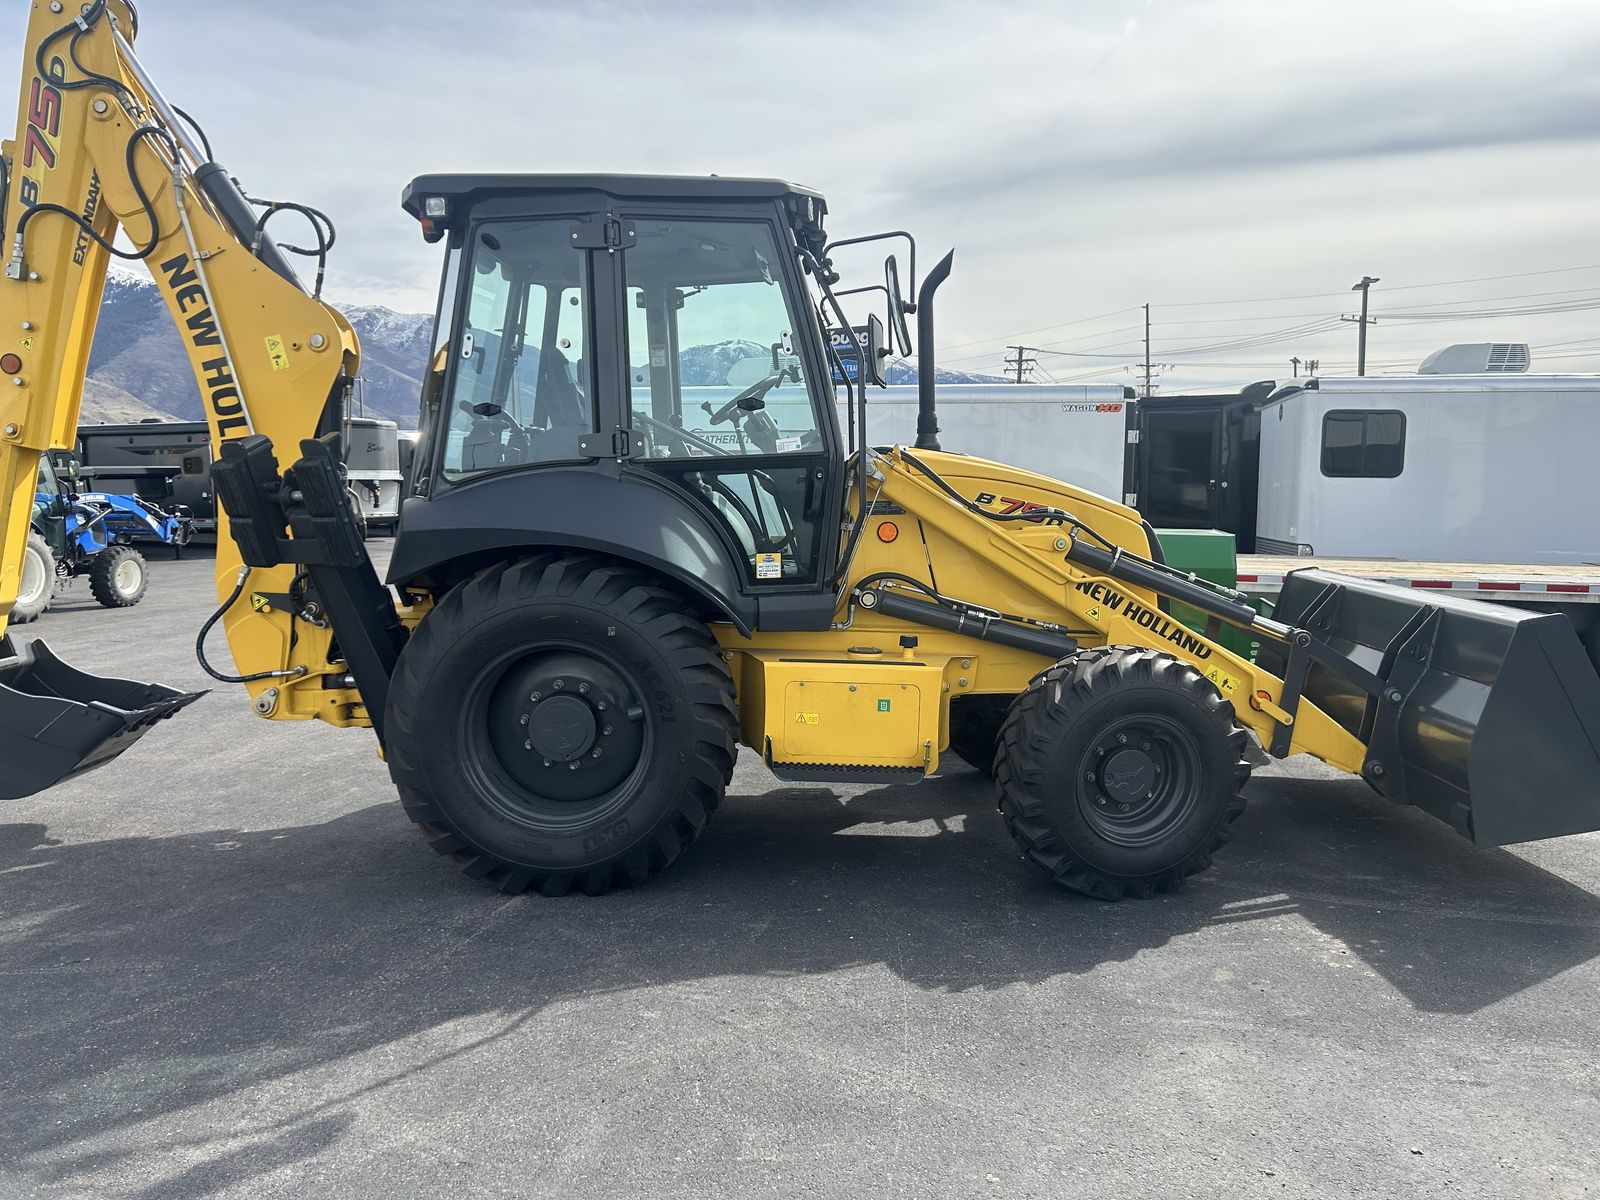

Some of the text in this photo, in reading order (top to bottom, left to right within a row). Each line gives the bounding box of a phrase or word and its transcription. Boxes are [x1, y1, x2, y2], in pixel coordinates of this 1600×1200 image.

[159, 252, 222, 347] NEW
[1061, 403, 1123, 413] WAGON HD
[1075, 575, 1212, 660] NEW HOLLAND
